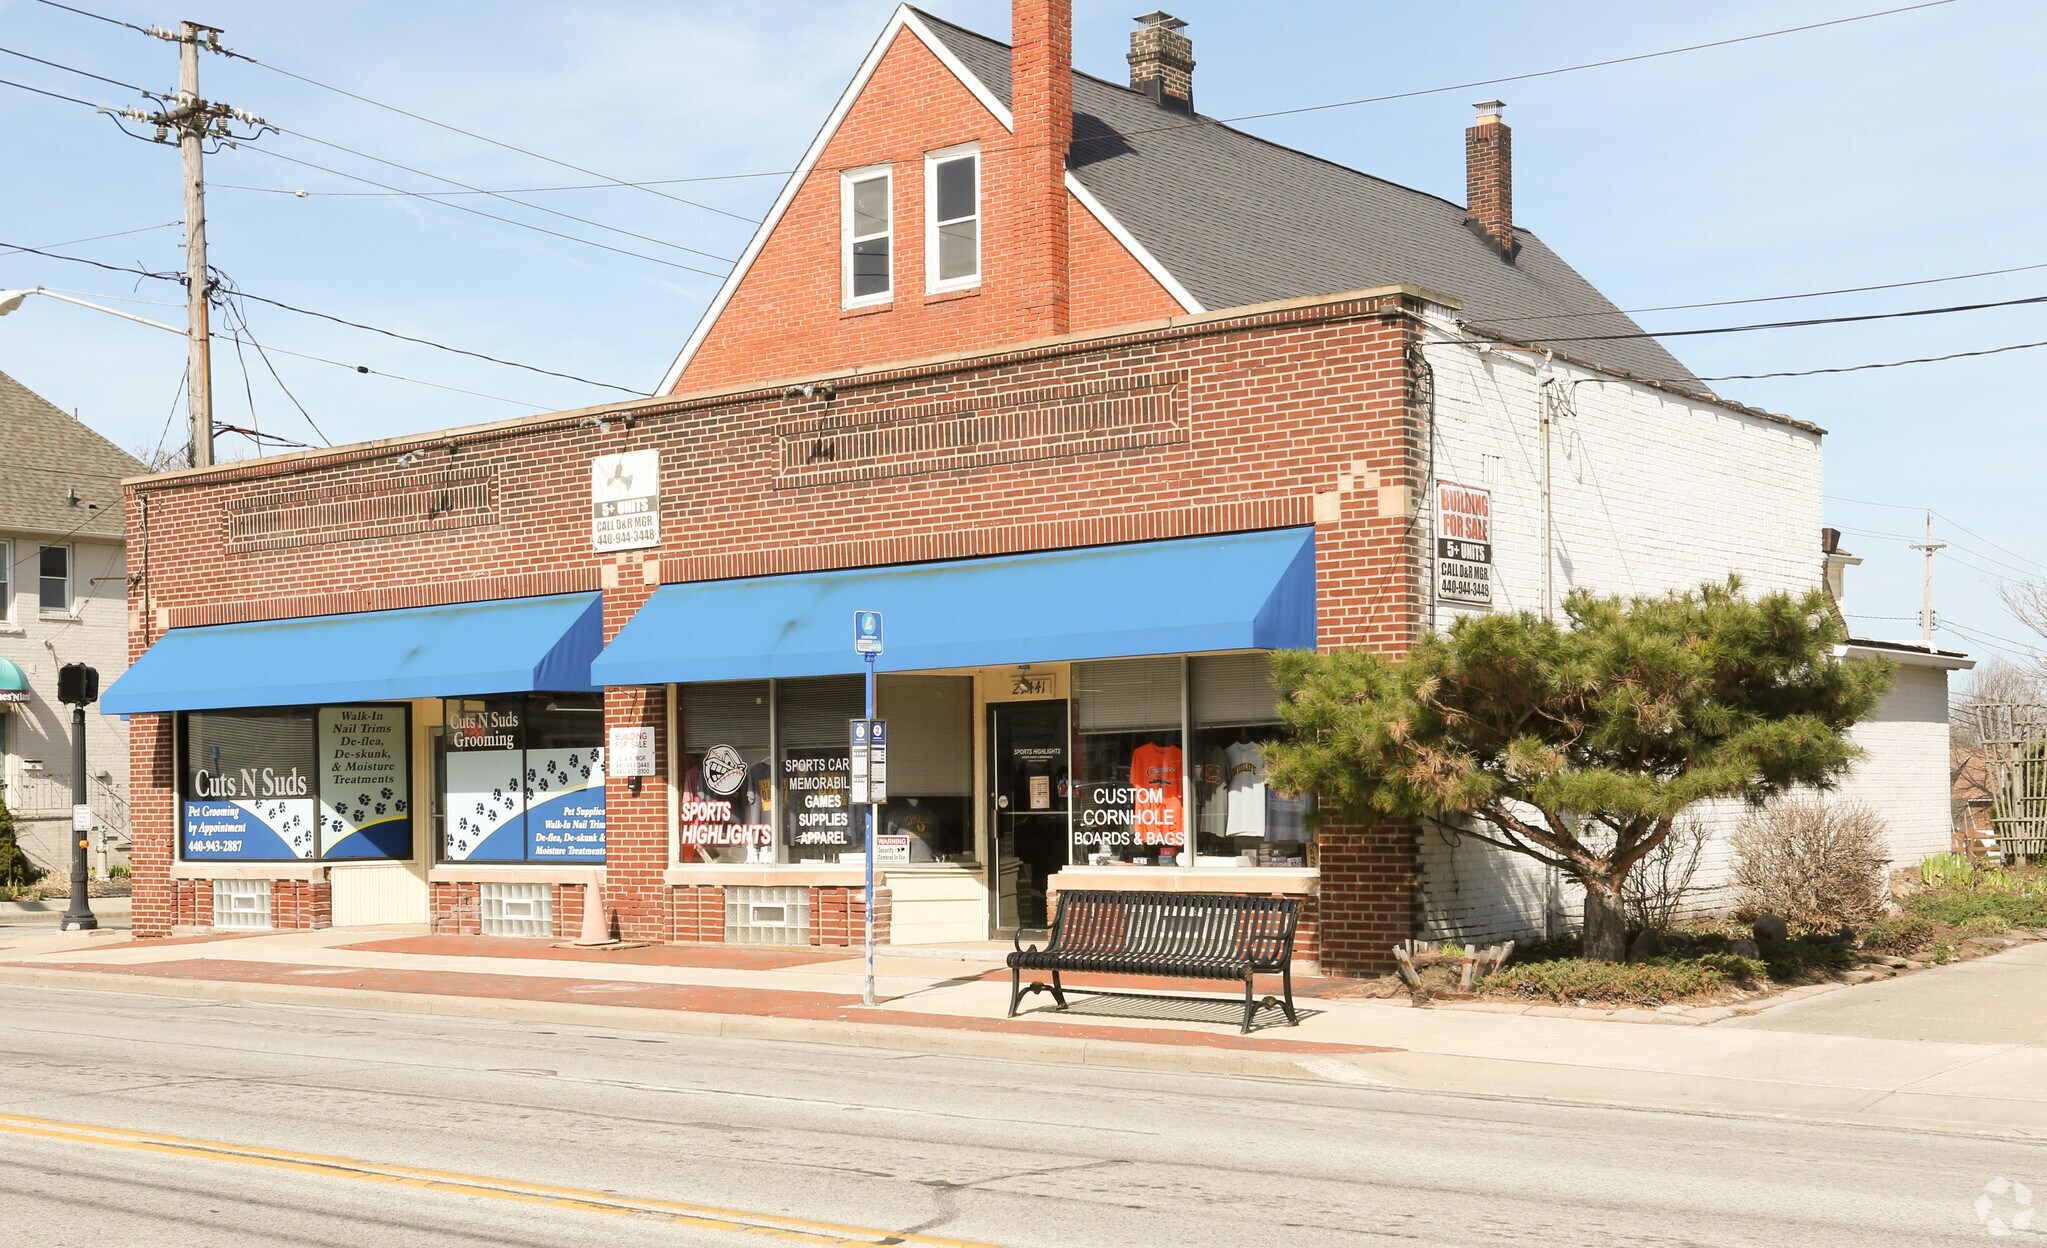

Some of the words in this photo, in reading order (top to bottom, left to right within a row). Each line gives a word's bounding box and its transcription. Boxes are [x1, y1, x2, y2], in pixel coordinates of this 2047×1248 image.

[602, 502, 615, 517] 5+
[617, 497, 649, 515] UNITS
[1441, 489, 1489, 517] BUILDING
[597, 520, 614, 532] CALL
[617, 518, 632, 530] D&R
[635, 515, 654, 527] MGR.
[1444, 514, 1464, 537] FOR
[1466, 516, 1487, 541] SALE
[597, 529, 655, 545] 440-944-3448
[1447, 541, 1460, 558] 5+
[1460, 542, 1485, 562] UNITS
[1441, 562, 1458, 577] CALL
[1459, 564, 1473, 579] D&R
[1474, 566, 1489, 580] MGR.
[1441, 579, 1489, 597] 440-944-3448
[342, 711, 383, 720] Walk-In
[450, 713, 476, 729] Cuts
[478, 712, 488, 728] N
[491, 711, 518, 728] Suds
[332, 724, 357, 733] Nail
[361, 724, 391, 733] Trims
[340, 736, 384, 747] De-flea,
[454, 730, 514, 749] Grooming
[615, 732, 647, 740] BUILDING
[631, 740, 647, 748] SALE
[334, 749, 391, 759] De-skunk,
[332, 762, 341, 771] &
[345, 762, 395, 771] Moisture
[785, 759, 826, 772] SPORTS
[195, 769, 236, 797] Cuts
[240, 768, 258, 796] N
[262, 767, 307, 796] Suds
[333, 775, 395, 784] Treatments
[804, 795, 842, 809] GAMES
[1093, 788, 1163, 804] CUSTOM
[188, 805, 201, 817] Pet
[202, 805, 240, 819] Grooming
[563, 807, 575, 816] Pet
[576, 807, 606, 817] Supplies
[681, 801, 732, 822] SPORTS
[1083, 809, 1175, 825] CORNHOLE
[545, 820, 571, 829] Walk-In
[572, 820, 588, 829] Nail
[798, 812, 848, 827] SUPPLIES
[188, 821, 198, 836] by
[198, 821, 247, 836] Appointment
[681, 824, 772, 845] HIGHLIGHTS
[564, 833, 598, 842] De-skunk
[599, 833, 606, 842] &
[800, 831, 848, 845] APPAREL
[1074, 832, 1130, 846] BOARDS
[1133, 832, 1142, 846] &
[1147, 832, 1184, 846] BAGS
[188, 840, 243, 852] 440-943-2887
[535, 846, 566, 855] Moisture
[568, 846, 606, 855] Treatments
